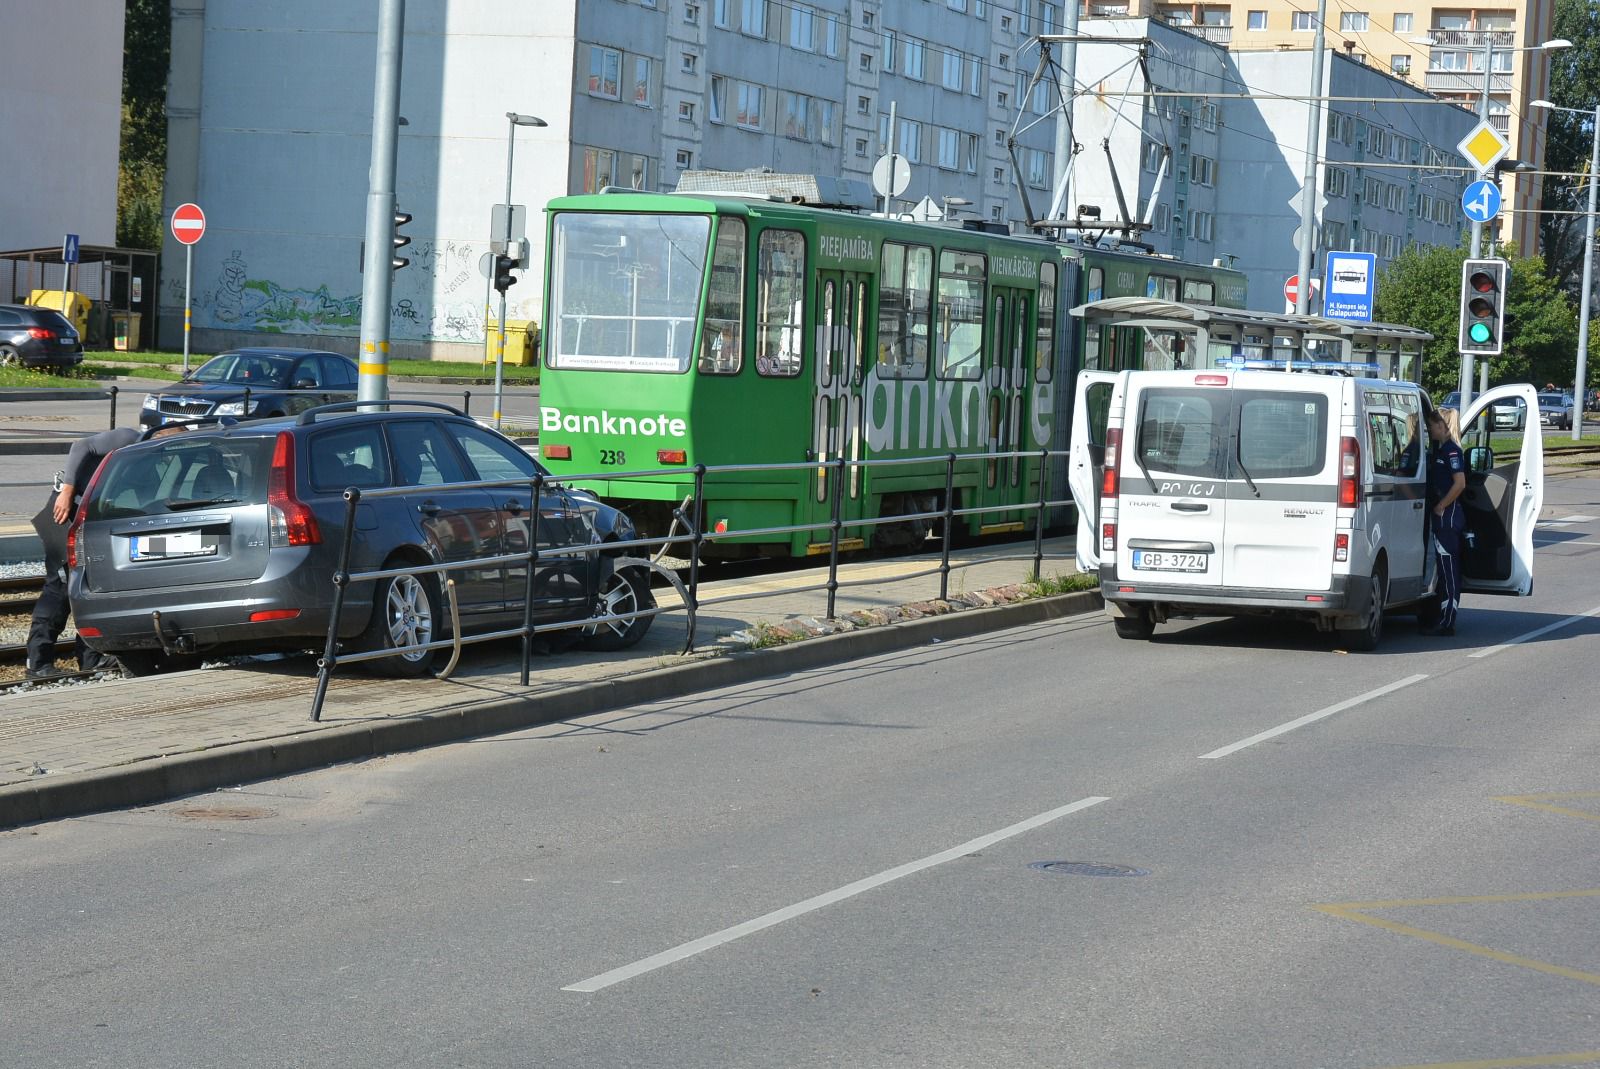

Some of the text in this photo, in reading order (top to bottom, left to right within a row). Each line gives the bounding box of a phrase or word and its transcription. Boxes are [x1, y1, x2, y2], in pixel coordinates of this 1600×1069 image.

[820, 235, 873, 263] PIEEJAMĪBA
[991, 255, 1037, 279] VIENKĀRŠĪBA
[1117, 272, 1135, 289] CIENA
[540, 407, 687, 437] Banknote
[600, 450, 626, 465] 238
[1284, 507, 1325, 515] RENAULT
[1143, 553, 1204, 568] GB-3724
